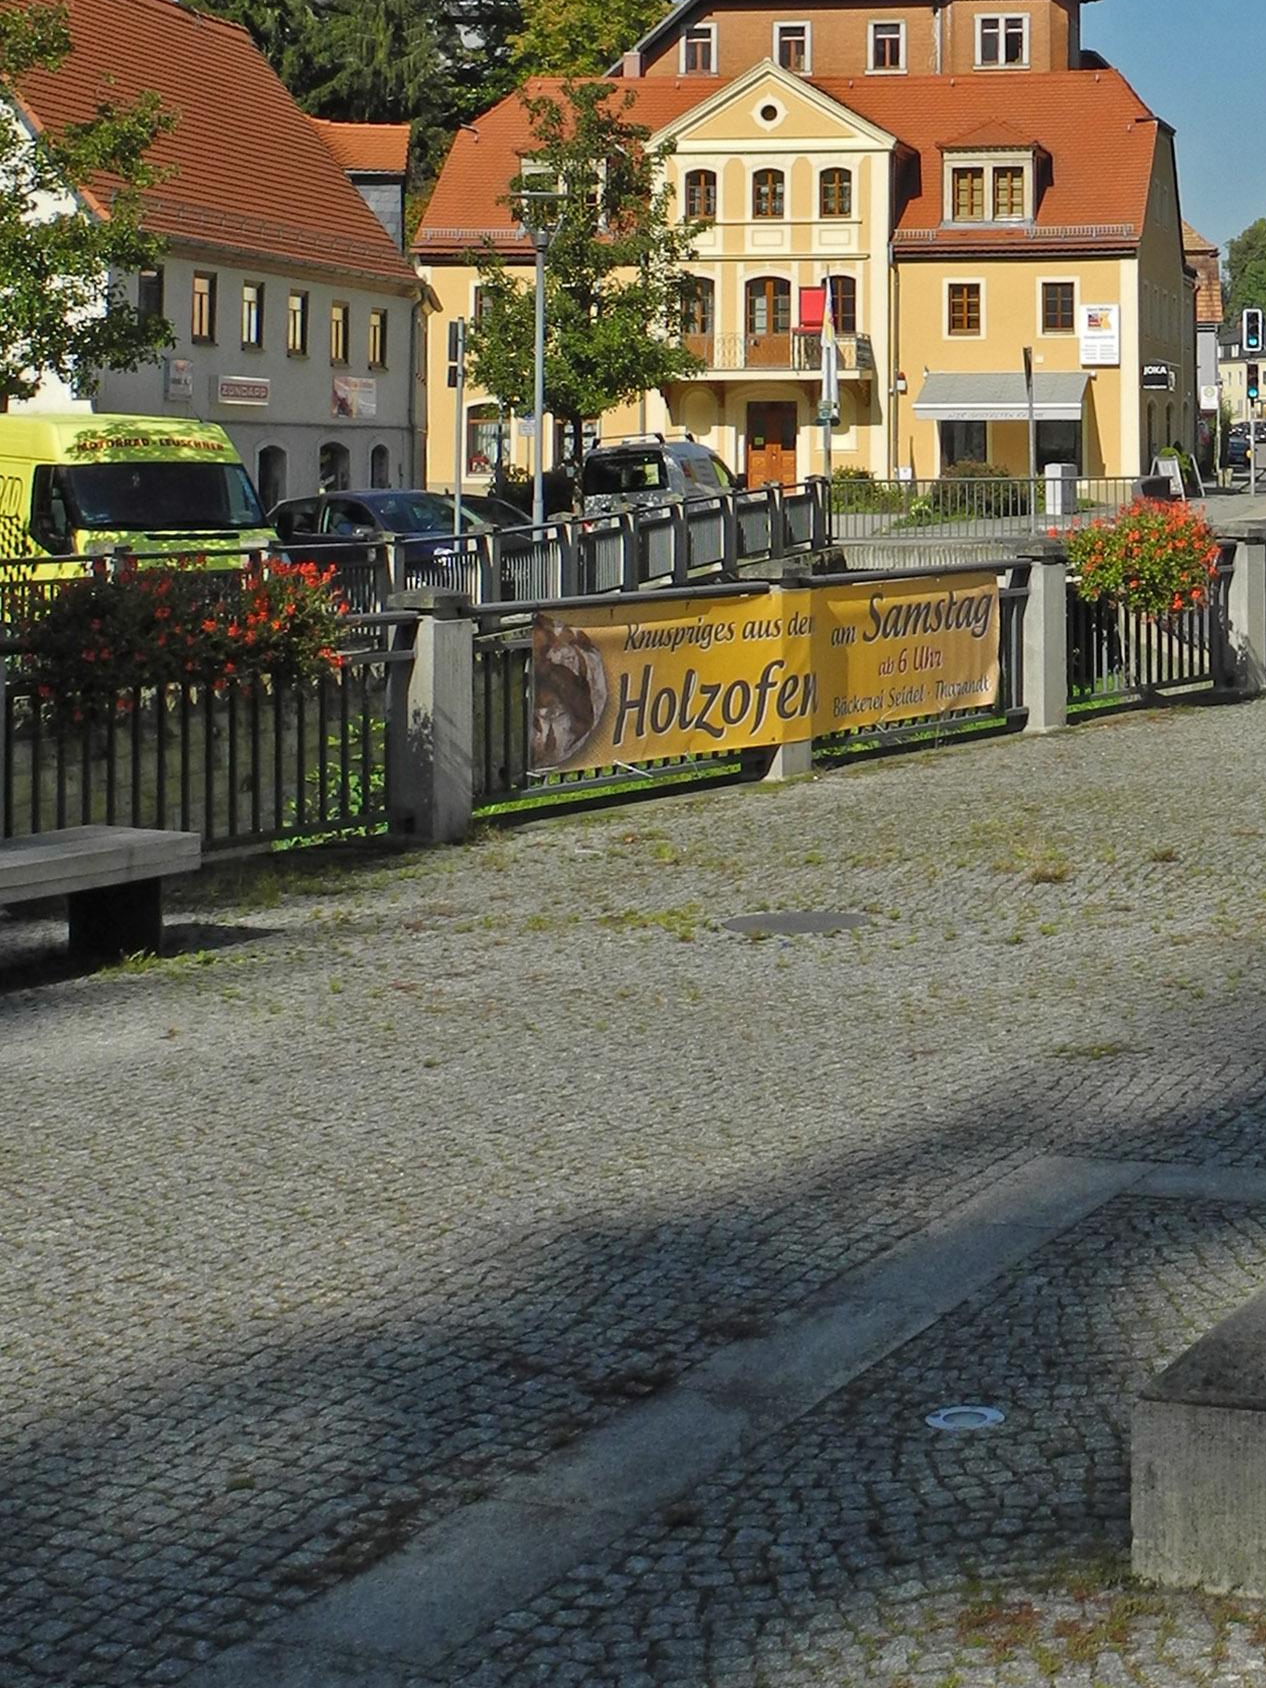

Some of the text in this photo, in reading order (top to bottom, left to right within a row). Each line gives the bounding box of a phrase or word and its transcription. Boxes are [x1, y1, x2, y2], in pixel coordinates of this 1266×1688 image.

[624, 618, 736, 653] Knuspriges
[742, 618, 783, 641] aus
[832, 591, 993, 645] am Samstag
[878, 646, 943, 676] ab 6 Uhr
[613, 660, 818, 746] Holzofen
[833, 690, 885, 717] Bäckerei
[888, 685, 924, 707] Seidel
